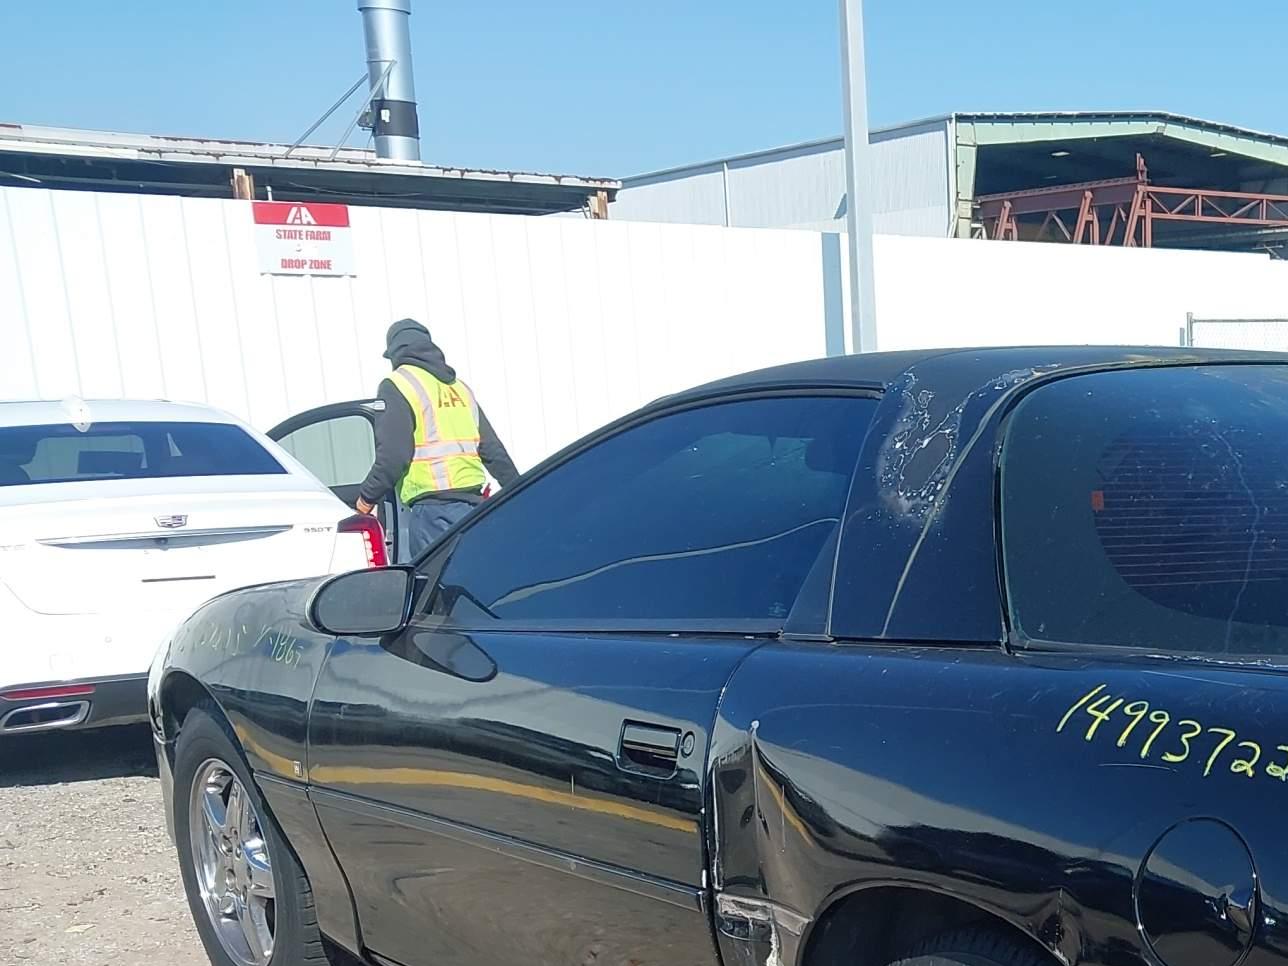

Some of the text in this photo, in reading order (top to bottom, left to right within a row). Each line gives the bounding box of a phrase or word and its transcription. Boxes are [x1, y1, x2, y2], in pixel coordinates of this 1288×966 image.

[275, 229, 331, 241] STATE FARM
[280, 258, 332, 270] DROP ZONE
